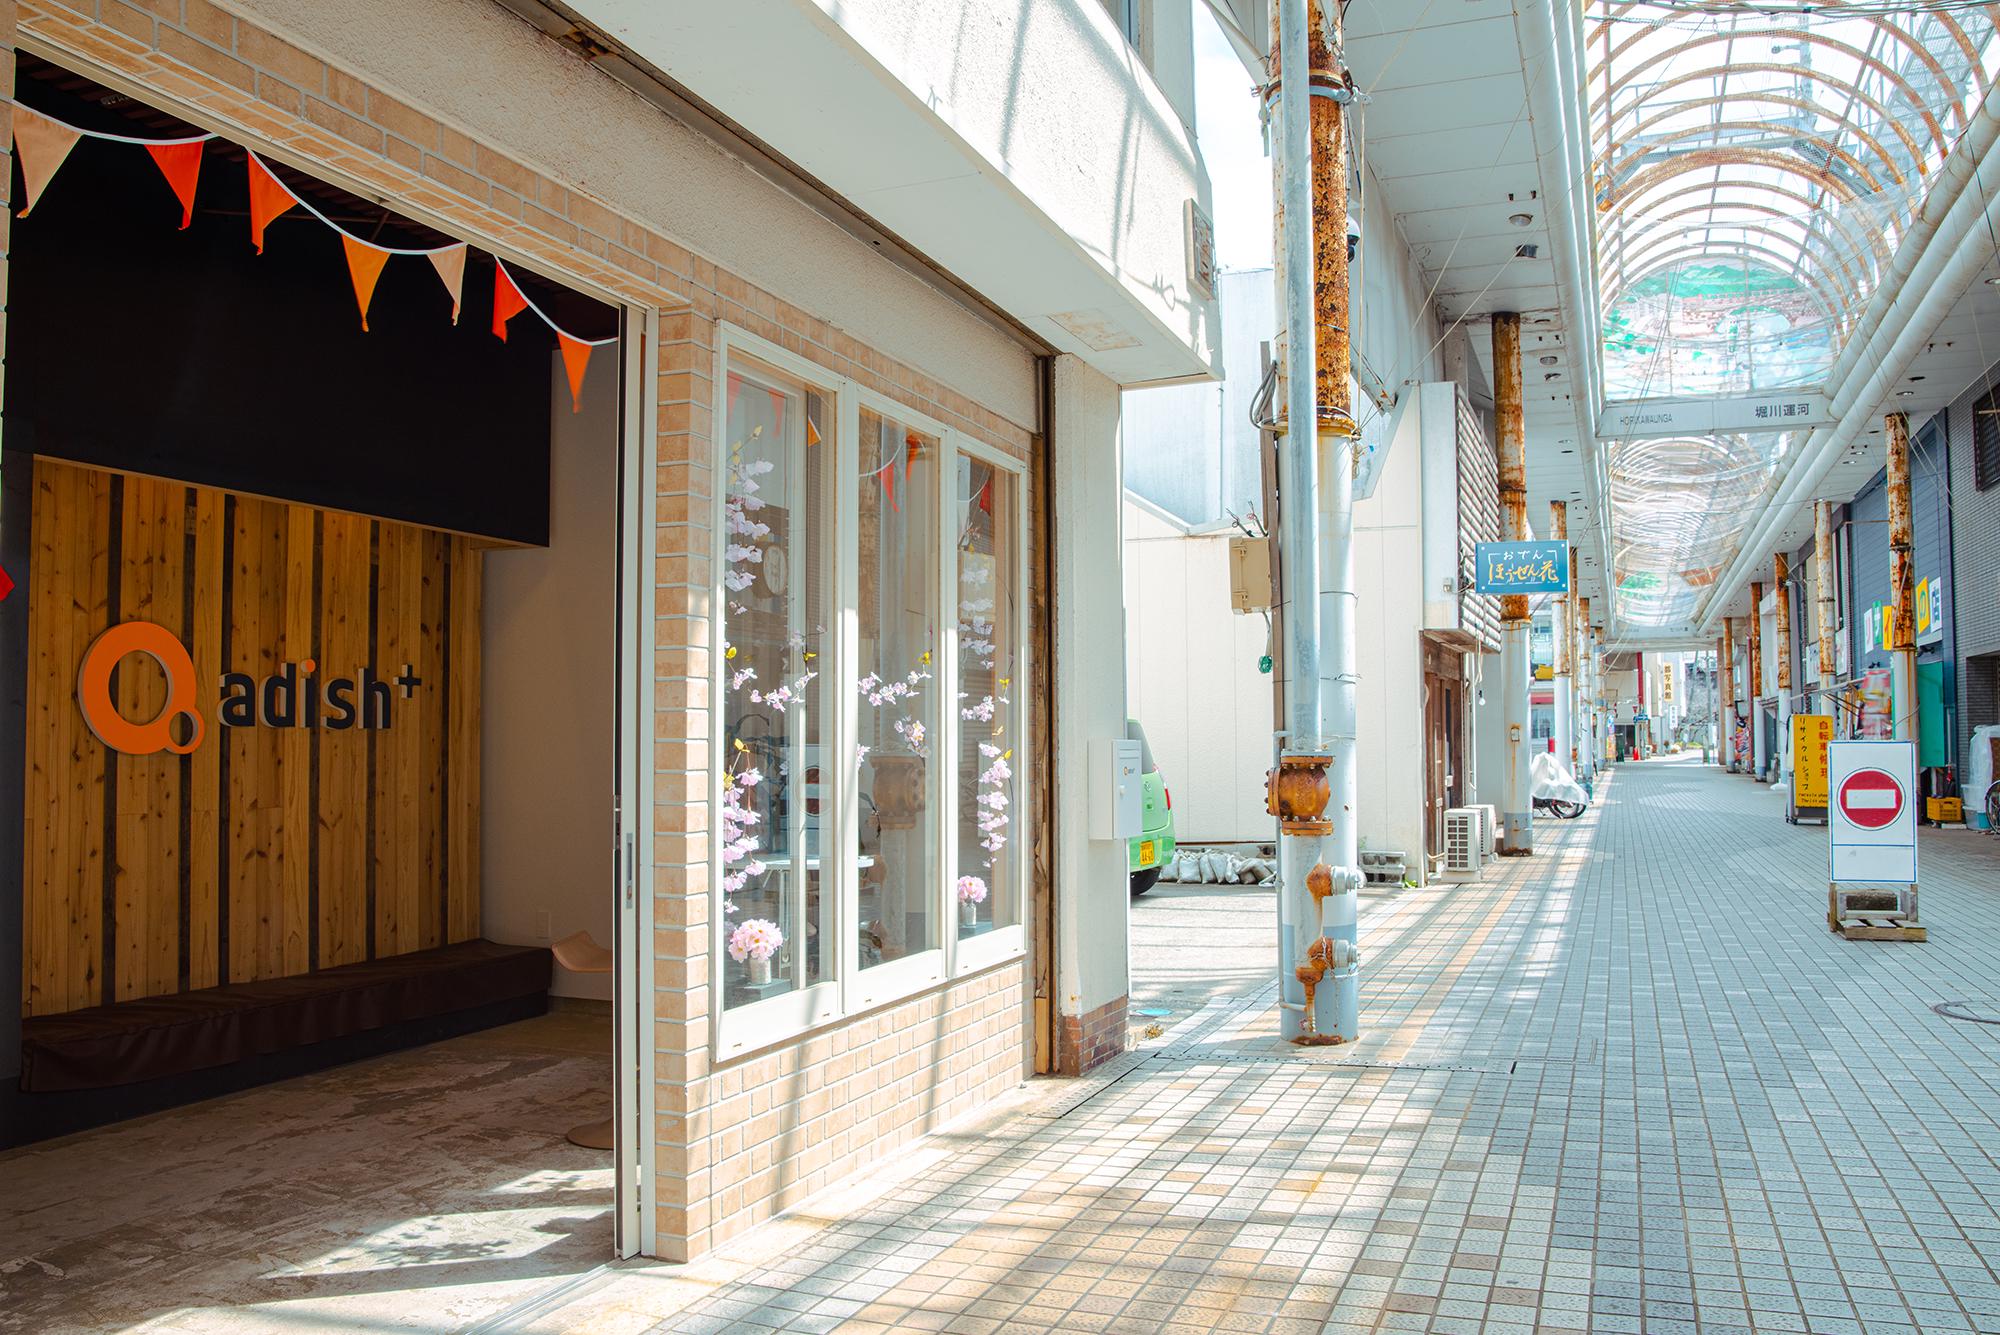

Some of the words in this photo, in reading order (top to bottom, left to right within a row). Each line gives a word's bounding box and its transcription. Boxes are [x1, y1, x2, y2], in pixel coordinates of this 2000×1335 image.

[1755, 403, 1810, 418] 堀川運河
[1503, 550, 1544, 560] おでん
[1800, 718, 1808, 790] リサイクルショップ
